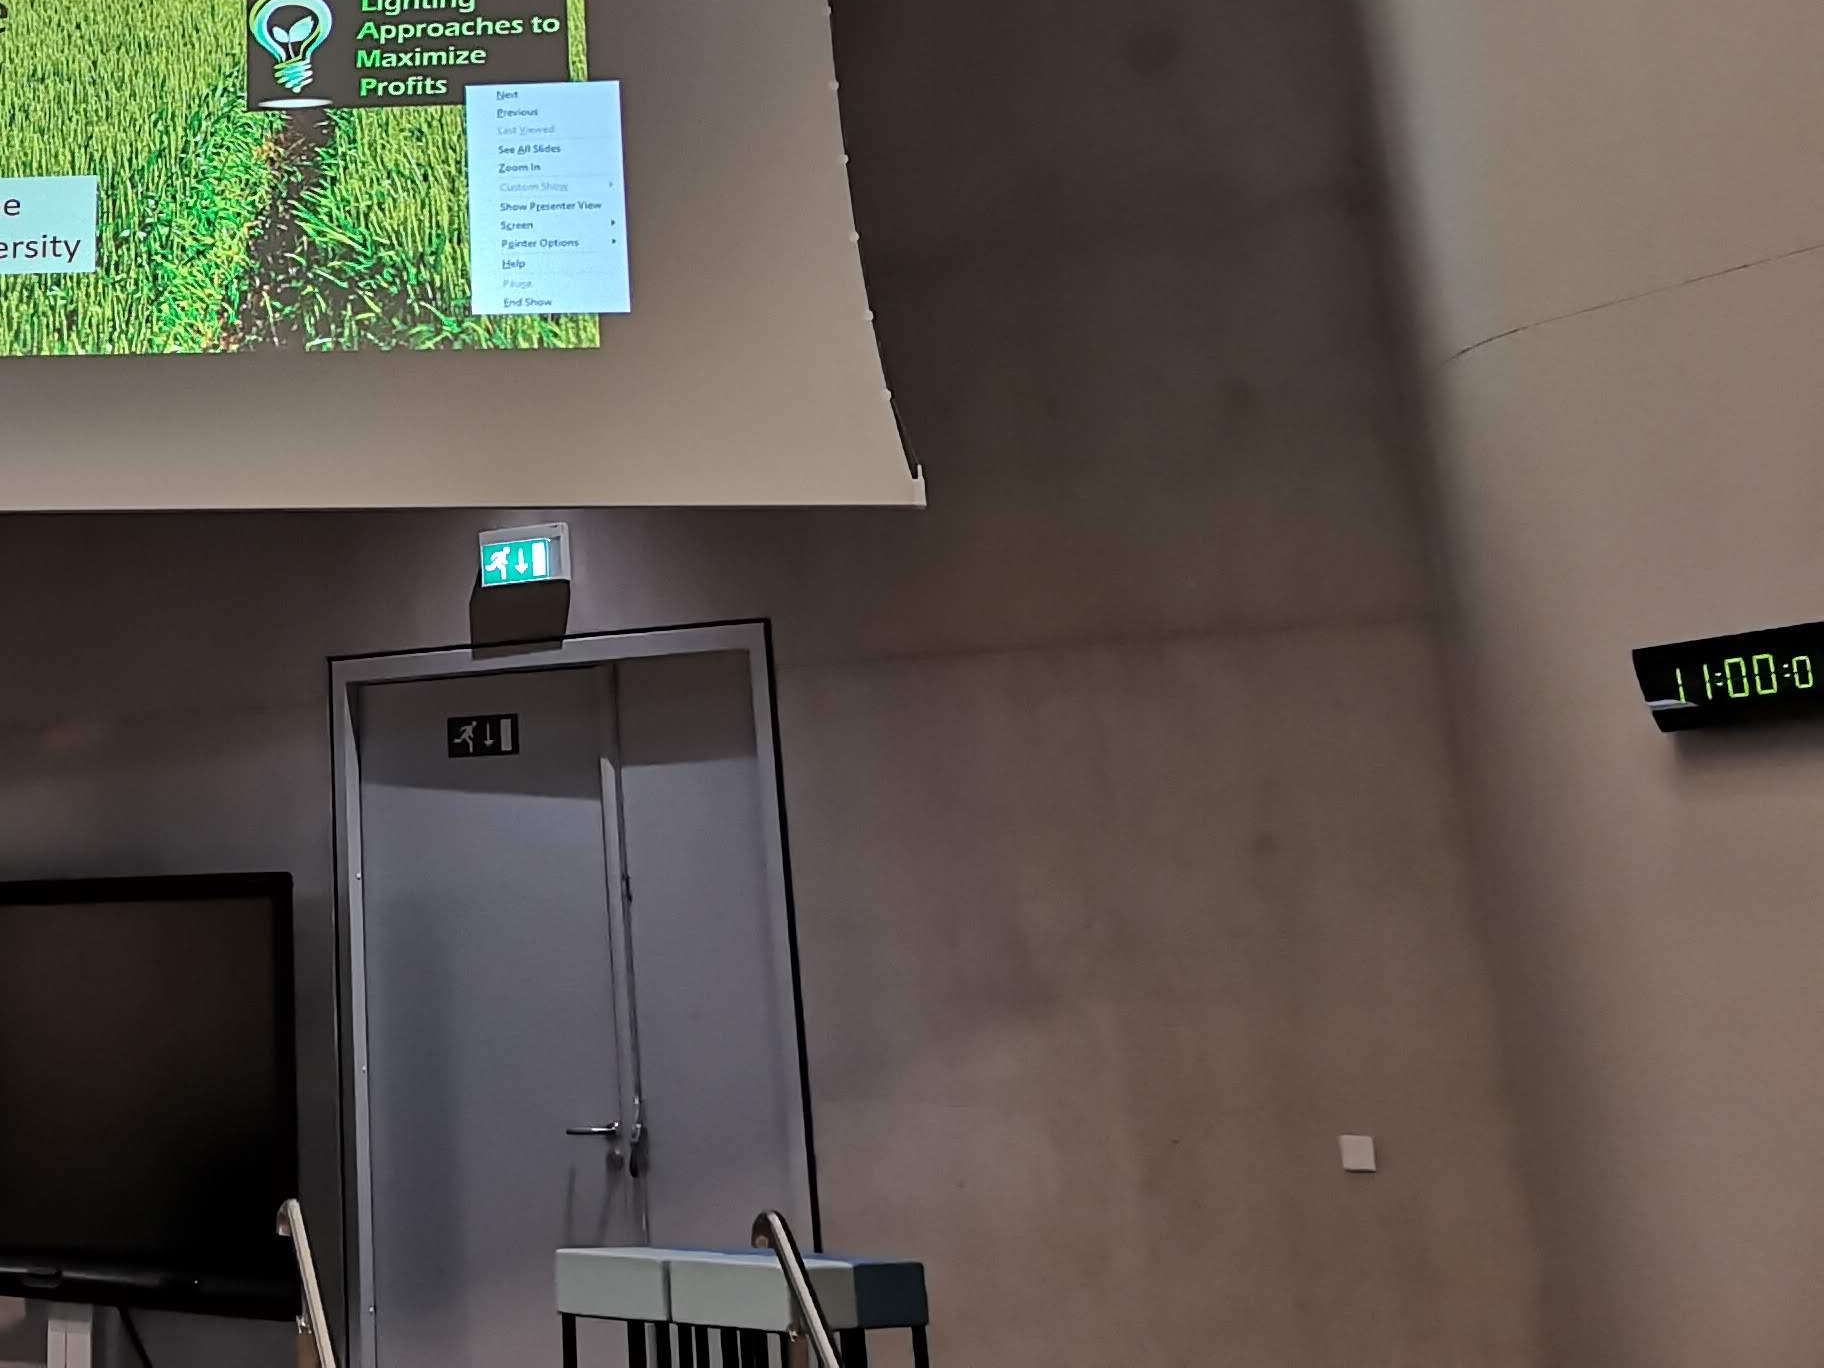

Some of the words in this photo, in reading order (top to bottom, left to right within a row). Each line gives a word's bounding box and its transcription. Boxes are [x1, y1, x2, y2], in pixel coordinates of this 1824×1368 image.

[356, 16, 524, 45] Approaches
[532, 16, 560, 34] to
[356, 45, 487, 69] Maximize
[359, 75, 448, 98] Profits
[496, 90, 519, 101] Next
[496, 108, 539, 119] Previous
[498, 145, 516, 154] See
[517, 144, 531, 155] All
[533, 144, 561, 154] Slides
[498, 163, 529, 174] Zoom
[531, 162, 541, 172] In
[500, 202, 526, 212] Show
[529, 201, 576, 213] Presenter
[578, 200, 603, 210] View
[500, 220, 534, 231] Screen
[501, 239, 537, 250] Pointer
[539, 238, 580, 249] Options
[502, 259, 526, 270] Help
[503, 298, 523, 308] End
[524, 297, 552, 307] Show
